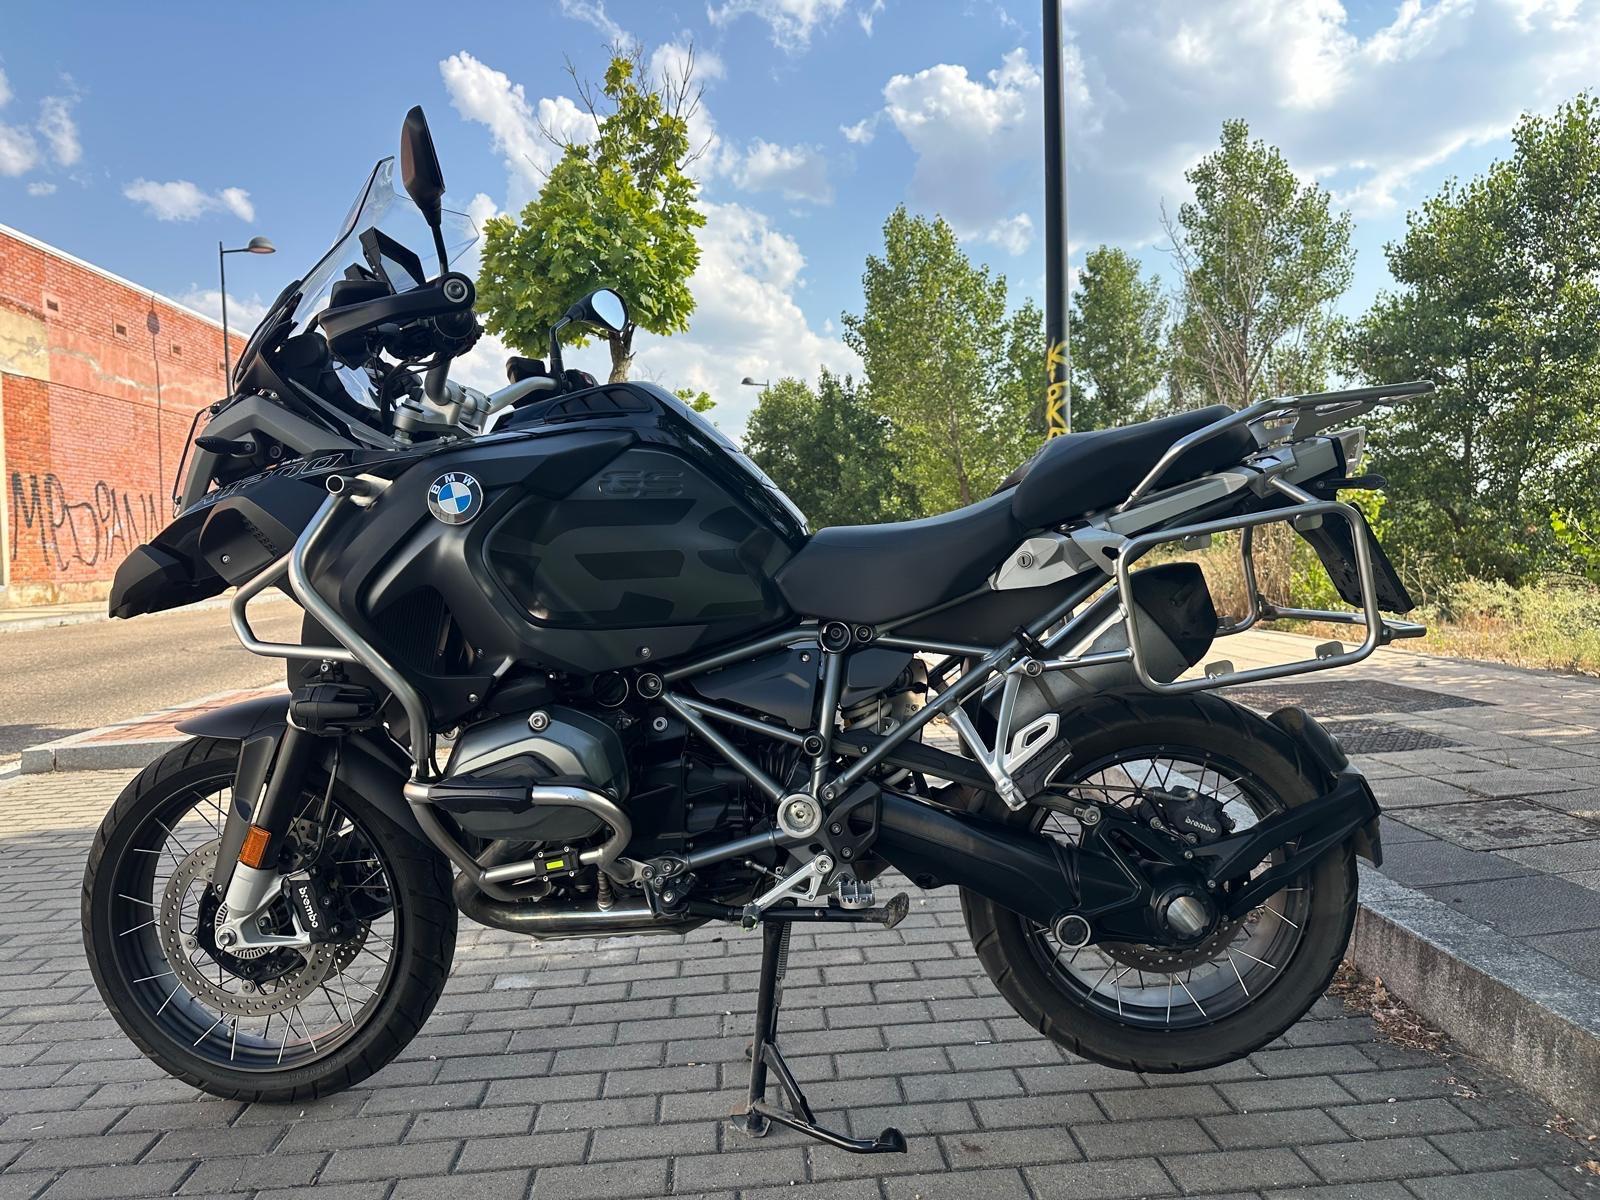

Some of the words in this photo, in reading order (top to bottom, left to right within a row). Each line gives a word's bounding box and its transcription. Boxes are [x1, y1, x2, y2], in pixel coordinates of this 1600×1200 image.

[431, 473, 474, 495] BMW
[1184, 815, 1217, 834] brembo
[298, 886, 319, 928] brembo
